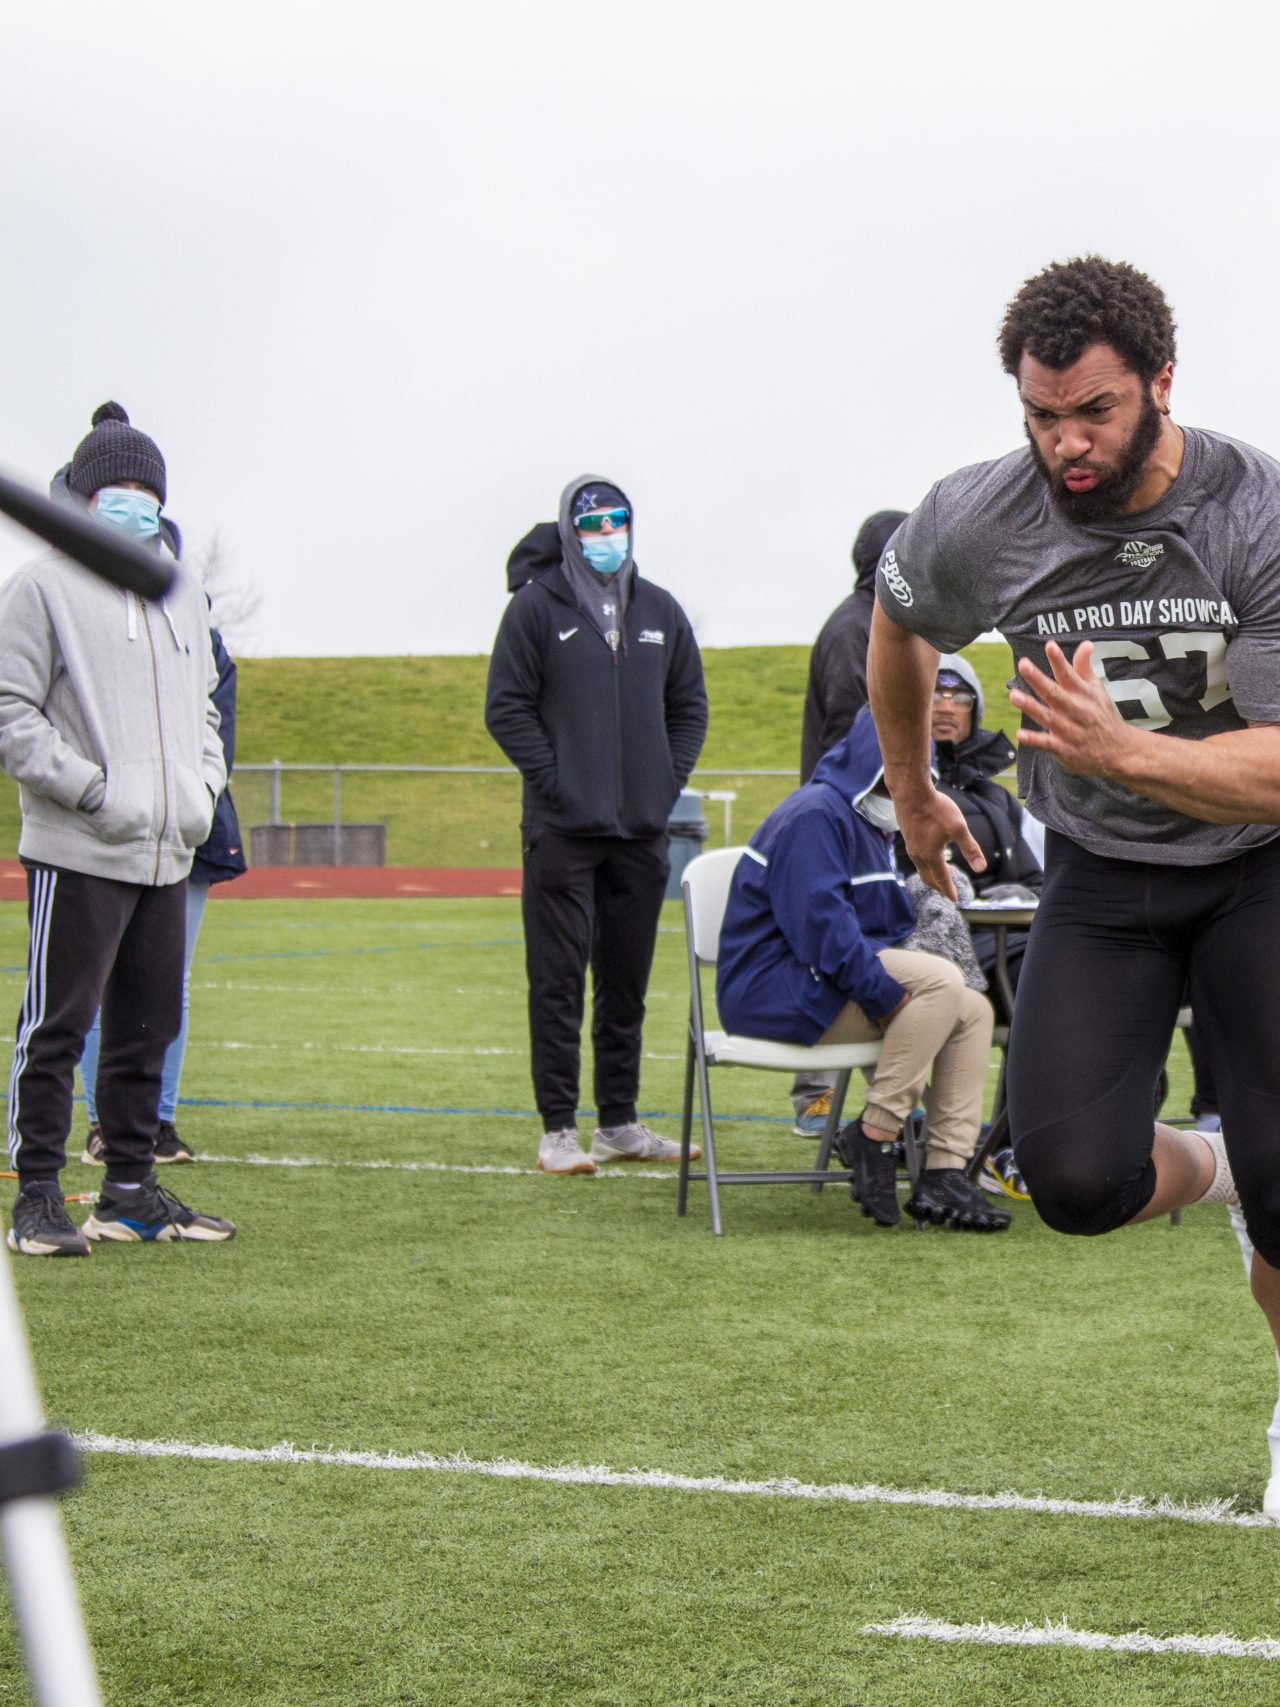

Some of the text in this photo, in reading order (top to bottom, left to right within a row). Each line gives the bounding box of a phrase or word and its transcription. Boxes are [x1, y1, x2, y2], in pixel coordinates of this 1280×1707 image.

[1036, 610, 1071, 636] AIA
[1073, 603, 1115, 631] PRO
[1119, 599, 1155, 626] DAY
[1091, 631, 1234, 731] 67
